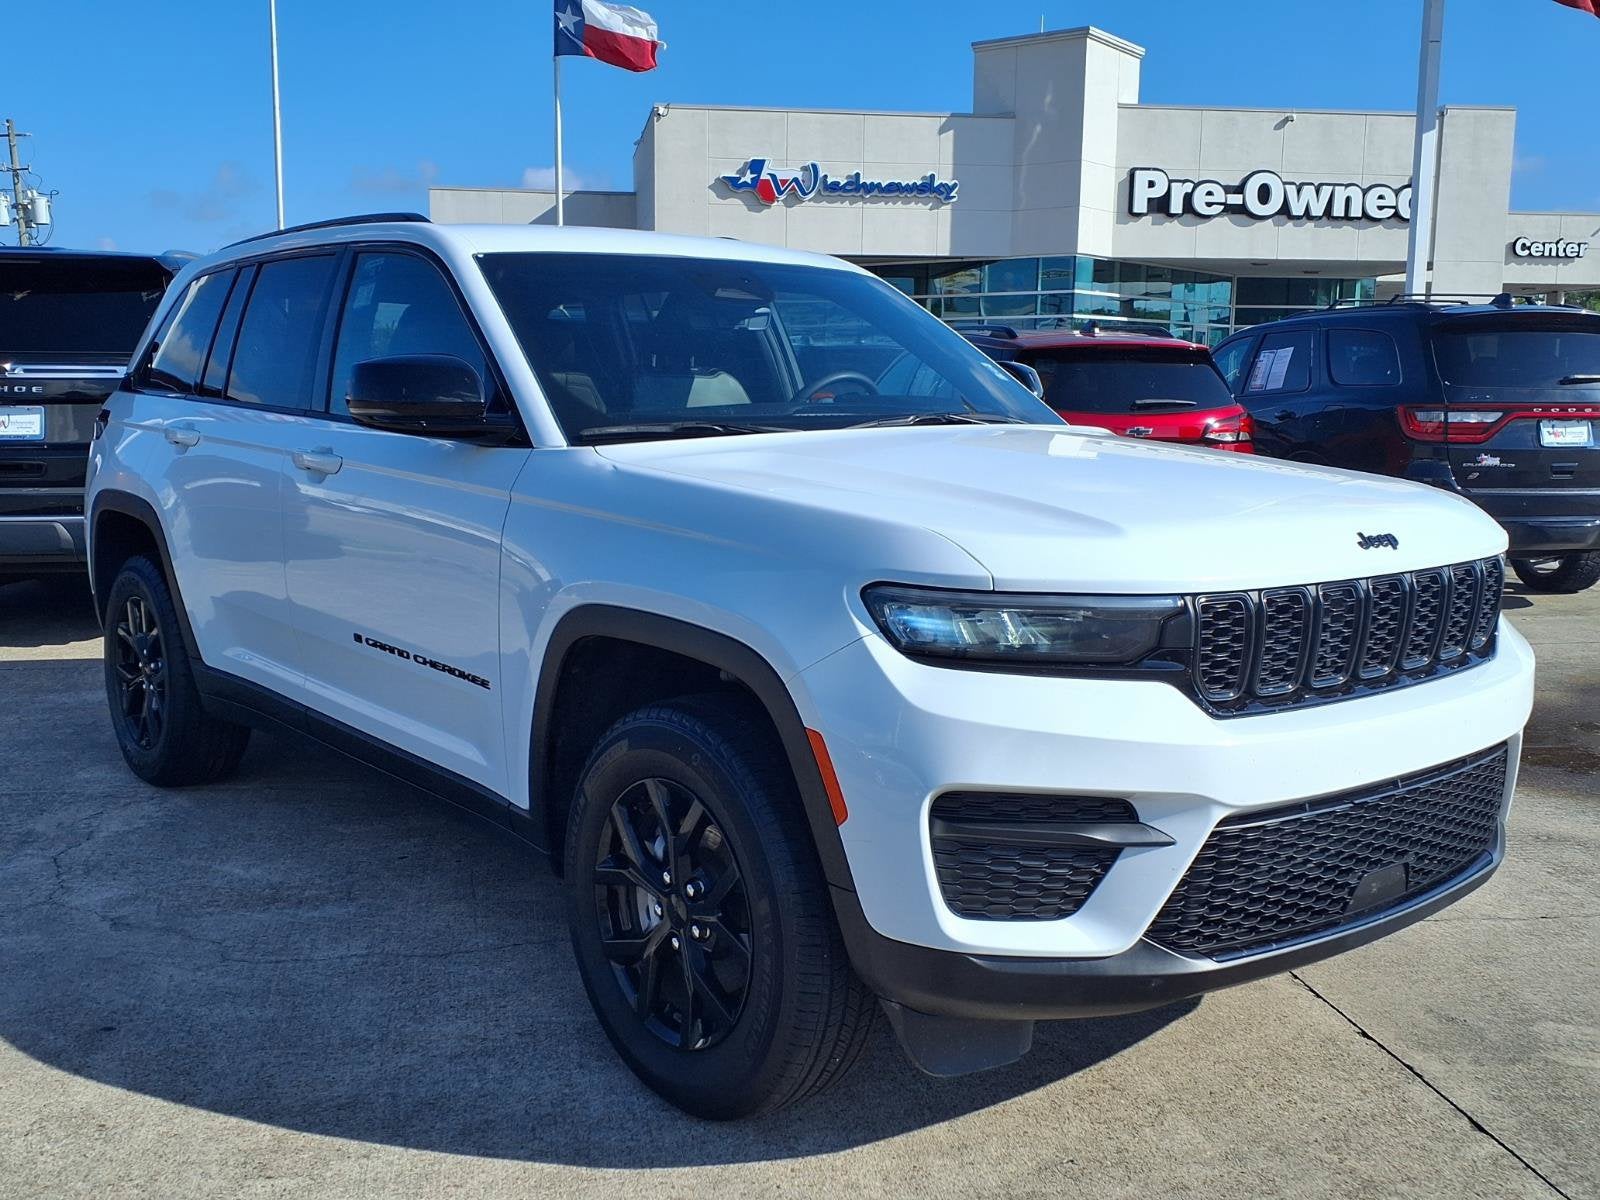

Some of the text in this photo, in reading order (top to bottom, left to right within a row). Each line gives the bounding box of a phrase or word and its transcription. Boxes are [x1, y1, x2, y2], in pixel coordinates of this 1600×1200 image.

[766, 161, 959, 203] Wischnewsky
[1512, 237, 1589, 259] Center
[1356, 531, 1399, 550] Jeep
[365, 637, 491, 690] GRAND CHEROKEE
